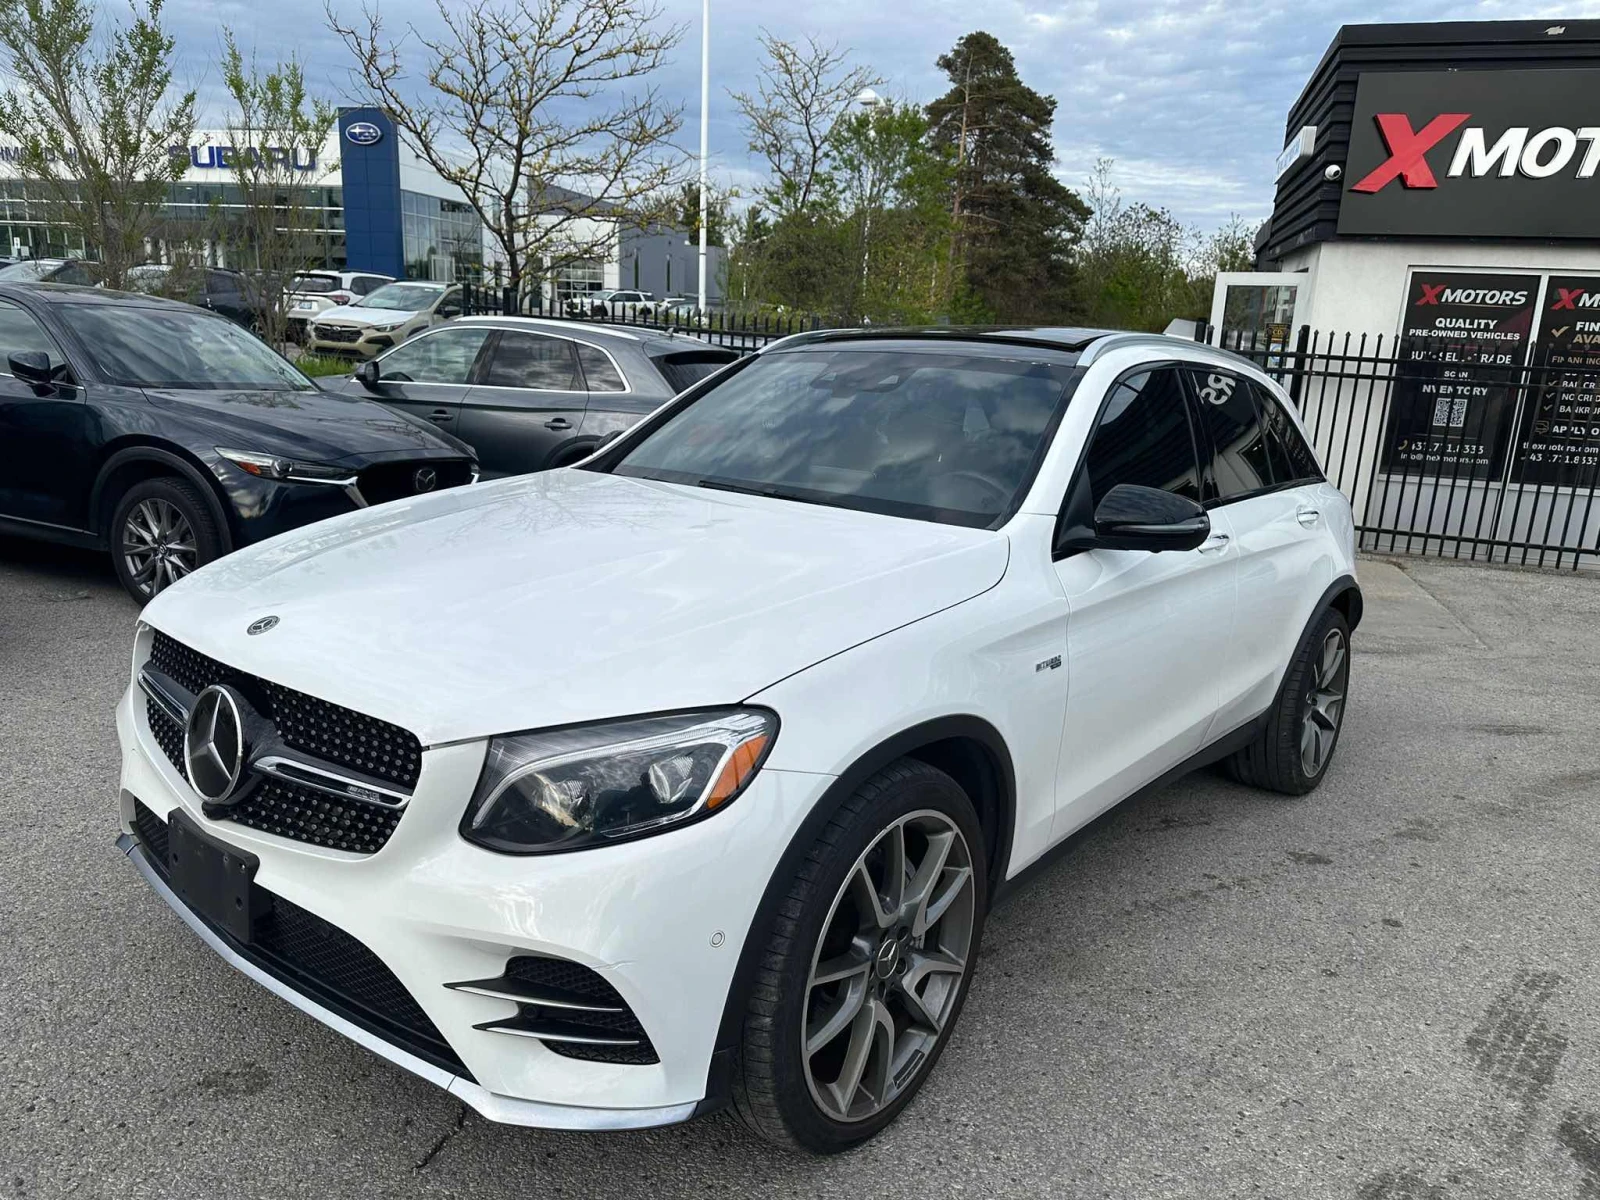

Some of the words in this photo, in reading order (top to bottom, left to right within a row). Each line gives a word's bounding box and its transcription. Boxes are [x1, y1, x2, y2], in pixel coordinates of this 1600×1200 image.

[1435, 317, 1498, 330] QUALITY
[1408, 328, 1467, 339] PRE-OWNED
[1470, 331, 1520, 341] VEHICLES
[1473, 353, 1512, 364] RADE
